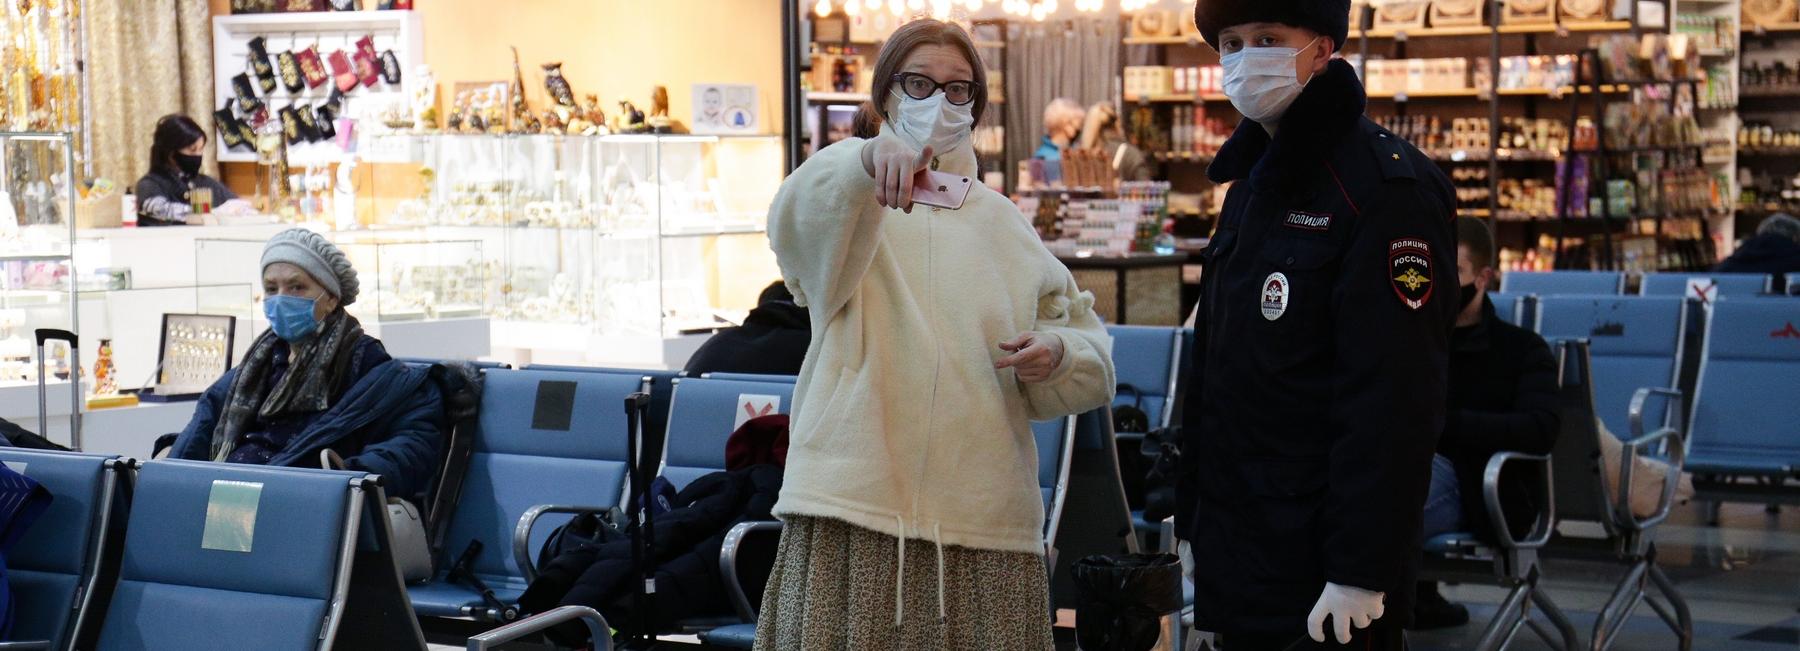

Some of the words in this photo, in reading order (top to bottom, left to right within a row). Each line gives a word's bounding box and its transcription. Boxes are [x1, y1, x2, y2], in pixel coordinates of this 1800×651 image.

[1287, 213, 1329, 227] ПОЛИЦИЯ
[1392, 240, 1428, 251] ПОЛИЦИЯ
[1394, 255, 1428, 268] РОССИЯ
